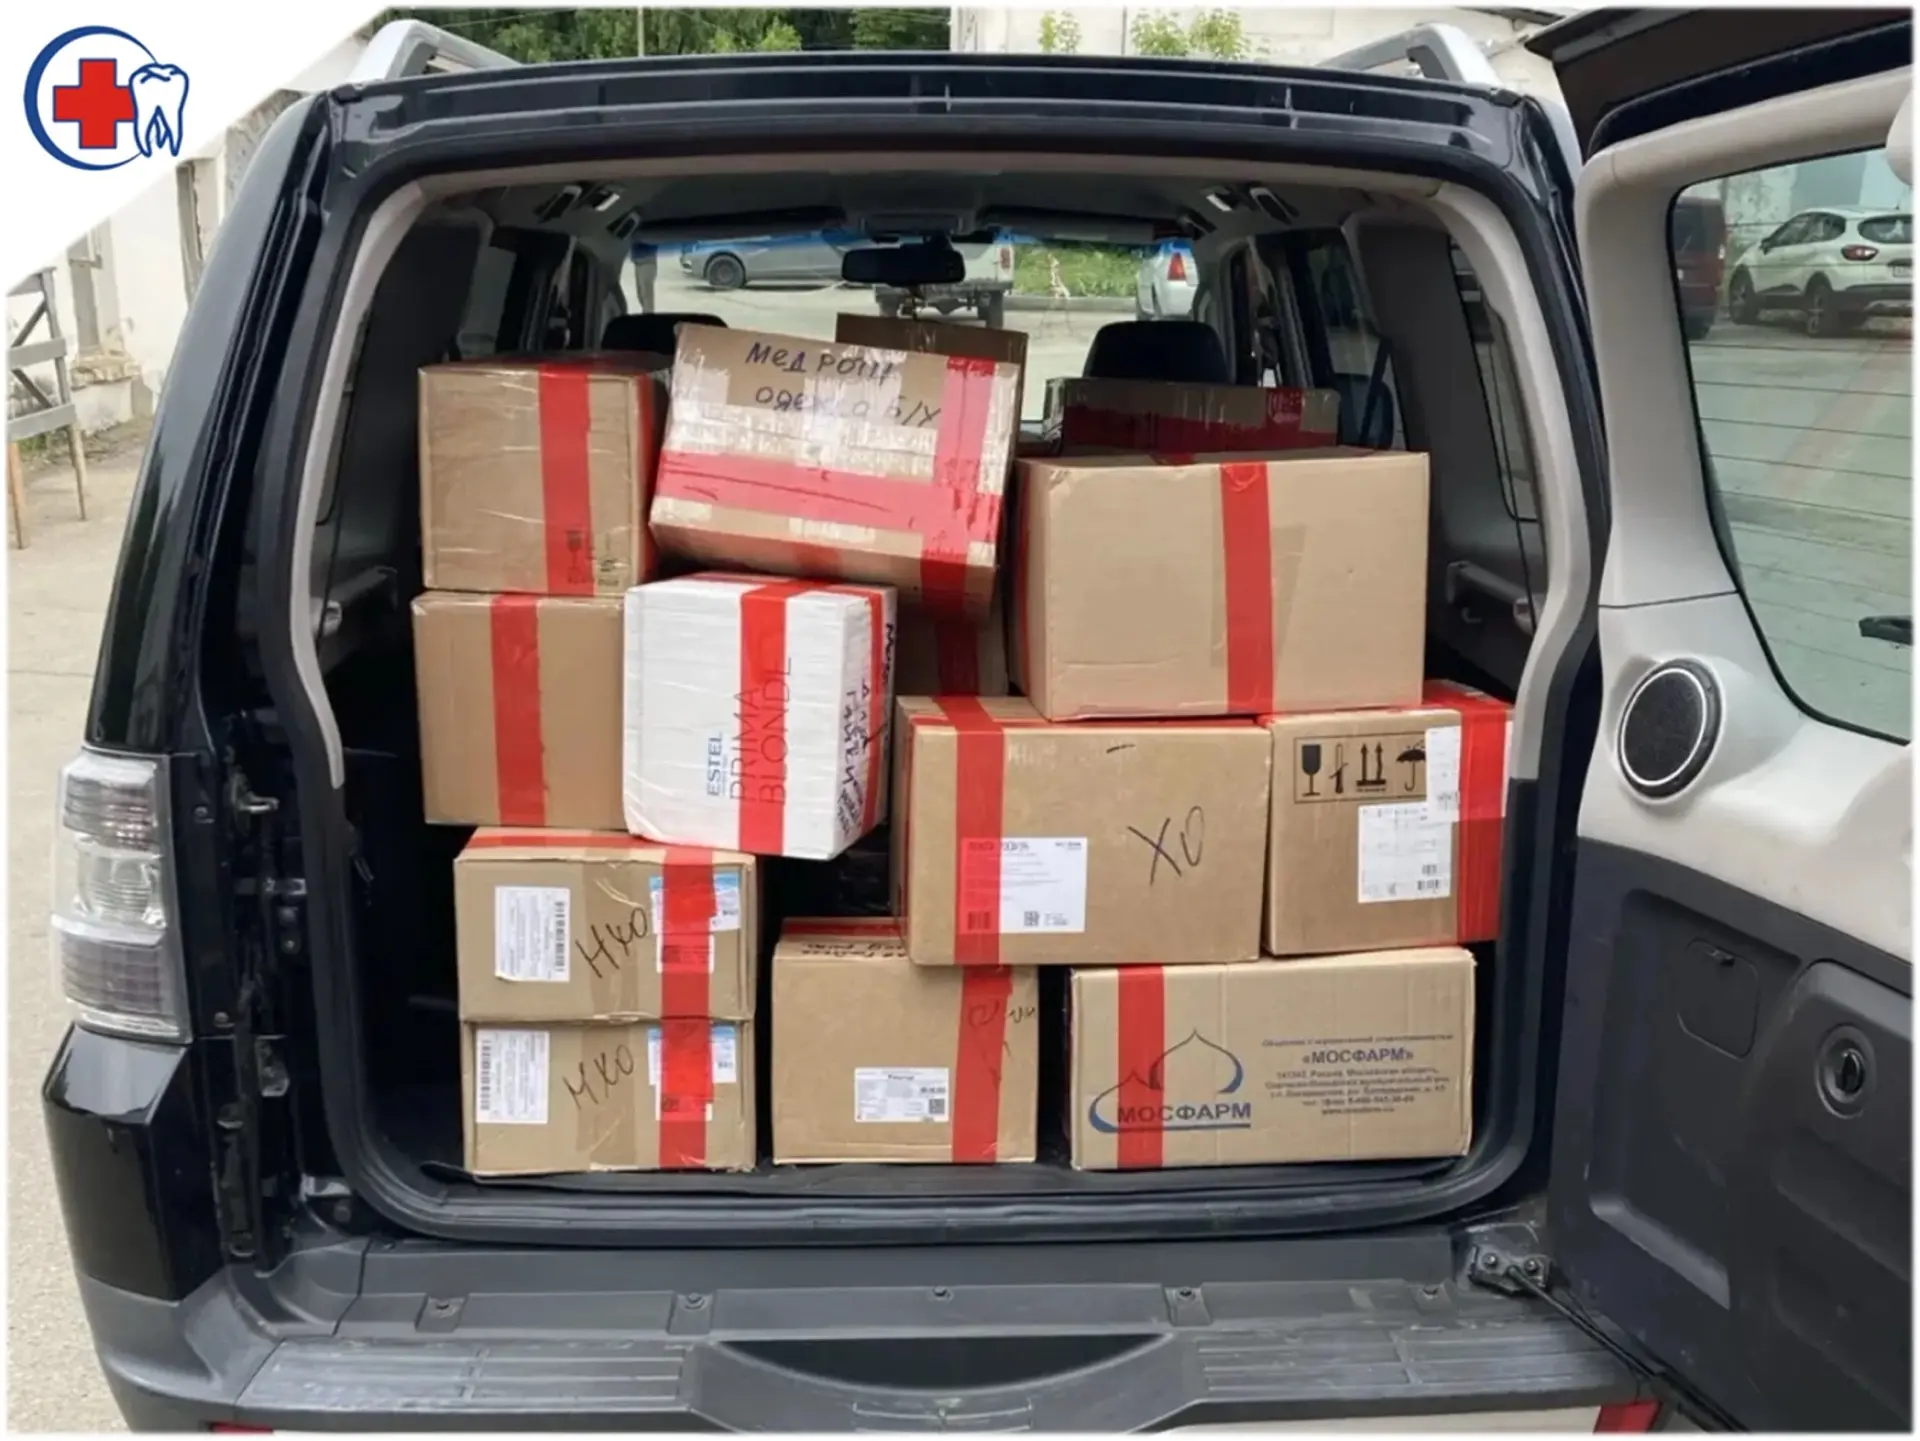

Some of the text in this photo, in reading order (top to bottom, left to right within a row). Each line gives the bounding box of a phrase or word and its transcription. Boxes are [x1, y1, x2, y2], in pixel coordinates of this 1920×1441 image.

[707, 732, 722, 796] ESTEL
[729, 687, 760, 800] PRIMA
[1302, 1047, 1414, 1064] «МОСФАРМ»
[1117, 1102, 1252, 1124] МОСФАРМ
